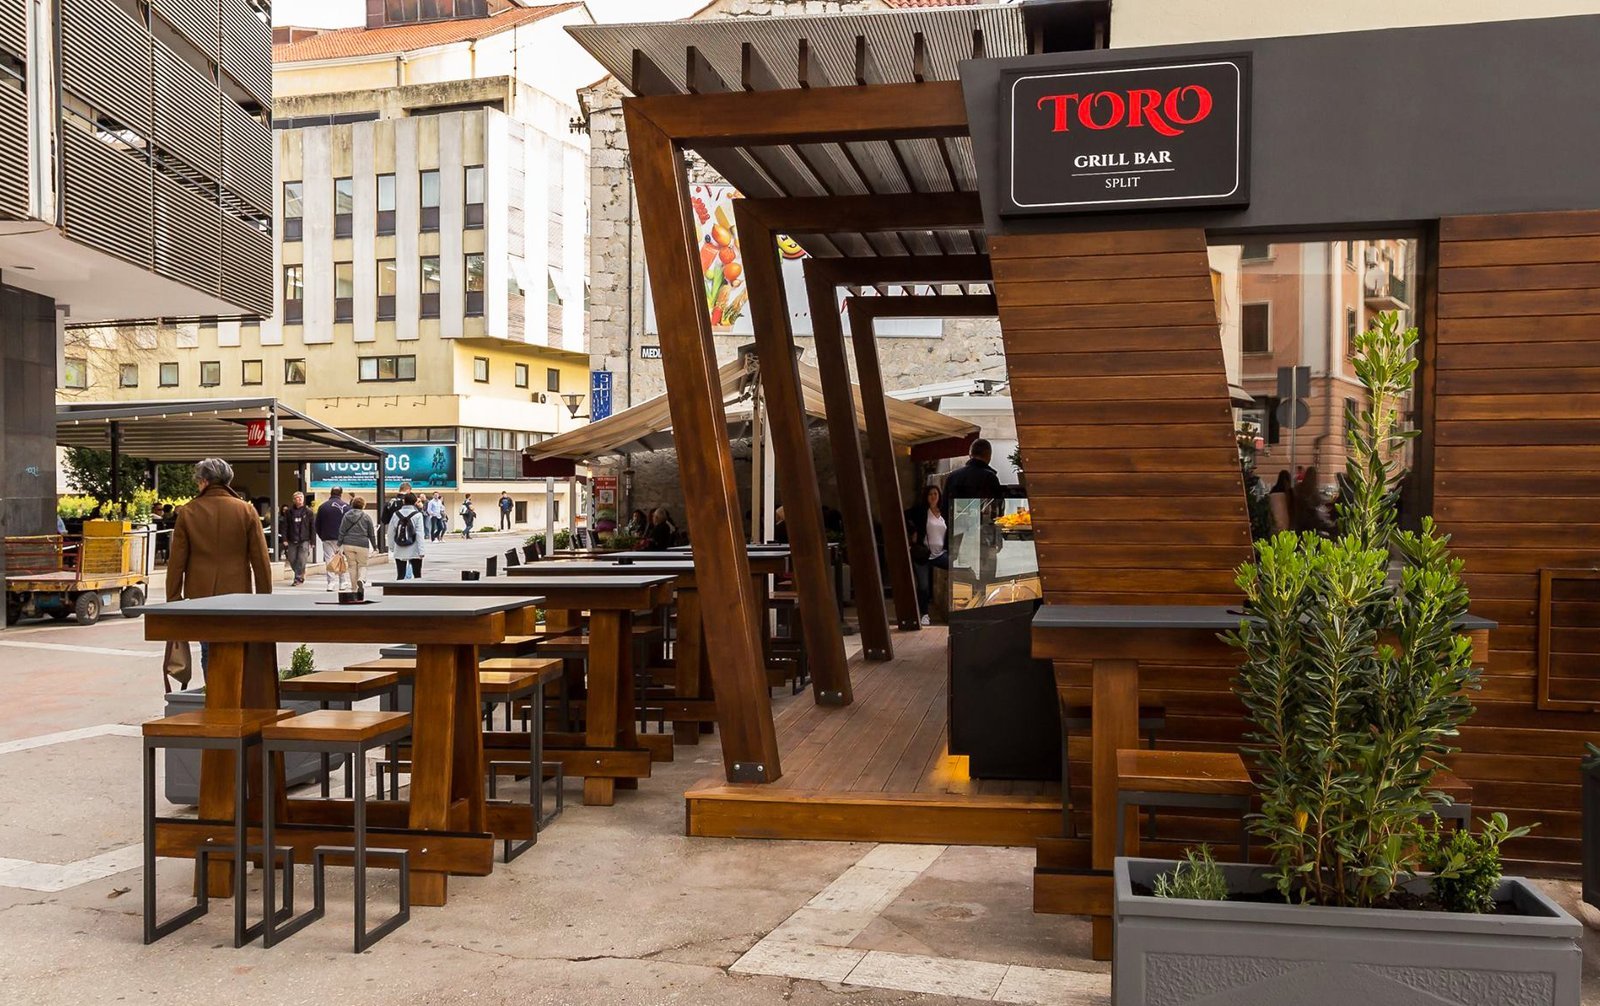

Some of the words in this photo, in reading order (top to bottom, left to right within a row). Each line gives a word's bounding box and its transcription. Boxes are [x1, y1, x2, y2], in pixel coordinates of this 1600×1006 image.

[1036, 84, 1213, 137] TORO
[1074, 152, 1130, 169] GRILL
[1134, 150, 1173, 166] BAR
[1105, 176, 1141, 189] SPLIT
[248, 424, 265, 444] illy
